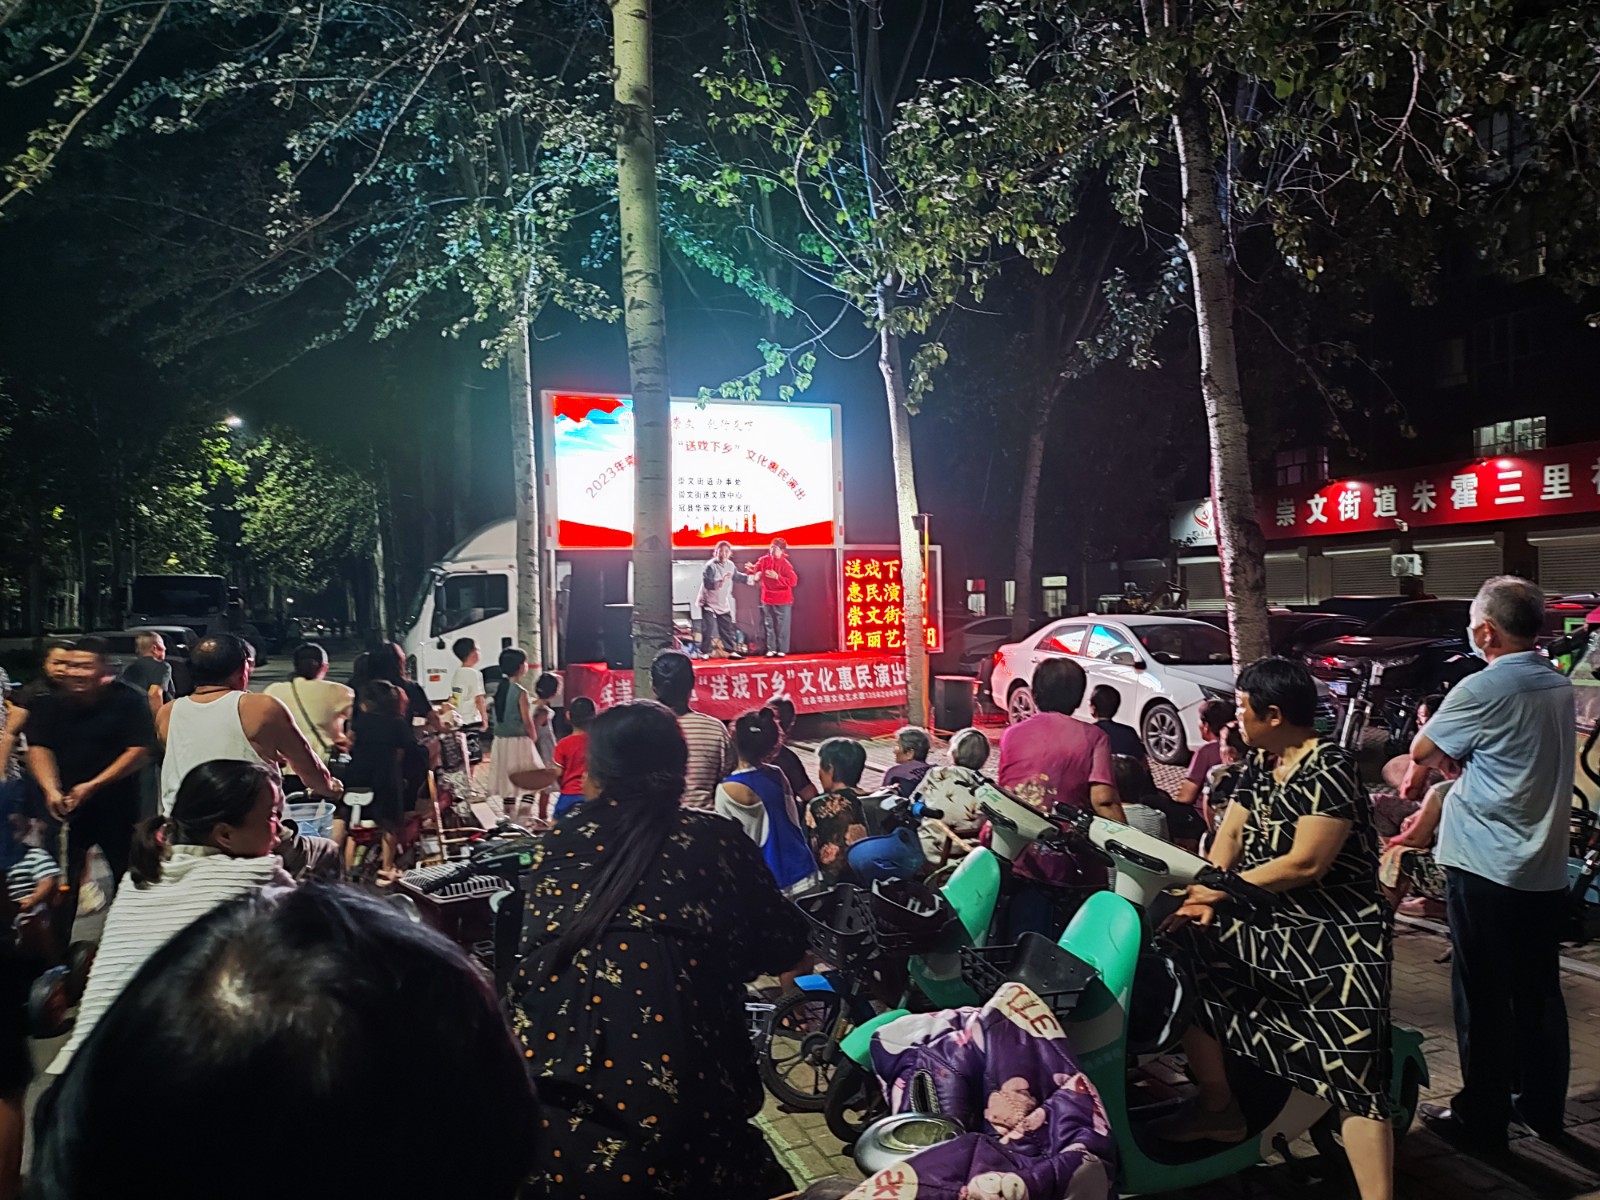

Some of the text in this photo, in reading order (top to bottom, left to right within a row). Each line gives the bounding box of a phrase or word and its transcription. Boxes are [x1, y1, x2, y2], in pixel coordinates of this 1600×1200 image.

[845, 558, 926, 579] 送戏下
[847, 581, 926, 603] 惠民演
[847, 605, 926, 627] 崇文街
[690, 662, 906, 701] “送戏下乡”文化惠民演出
